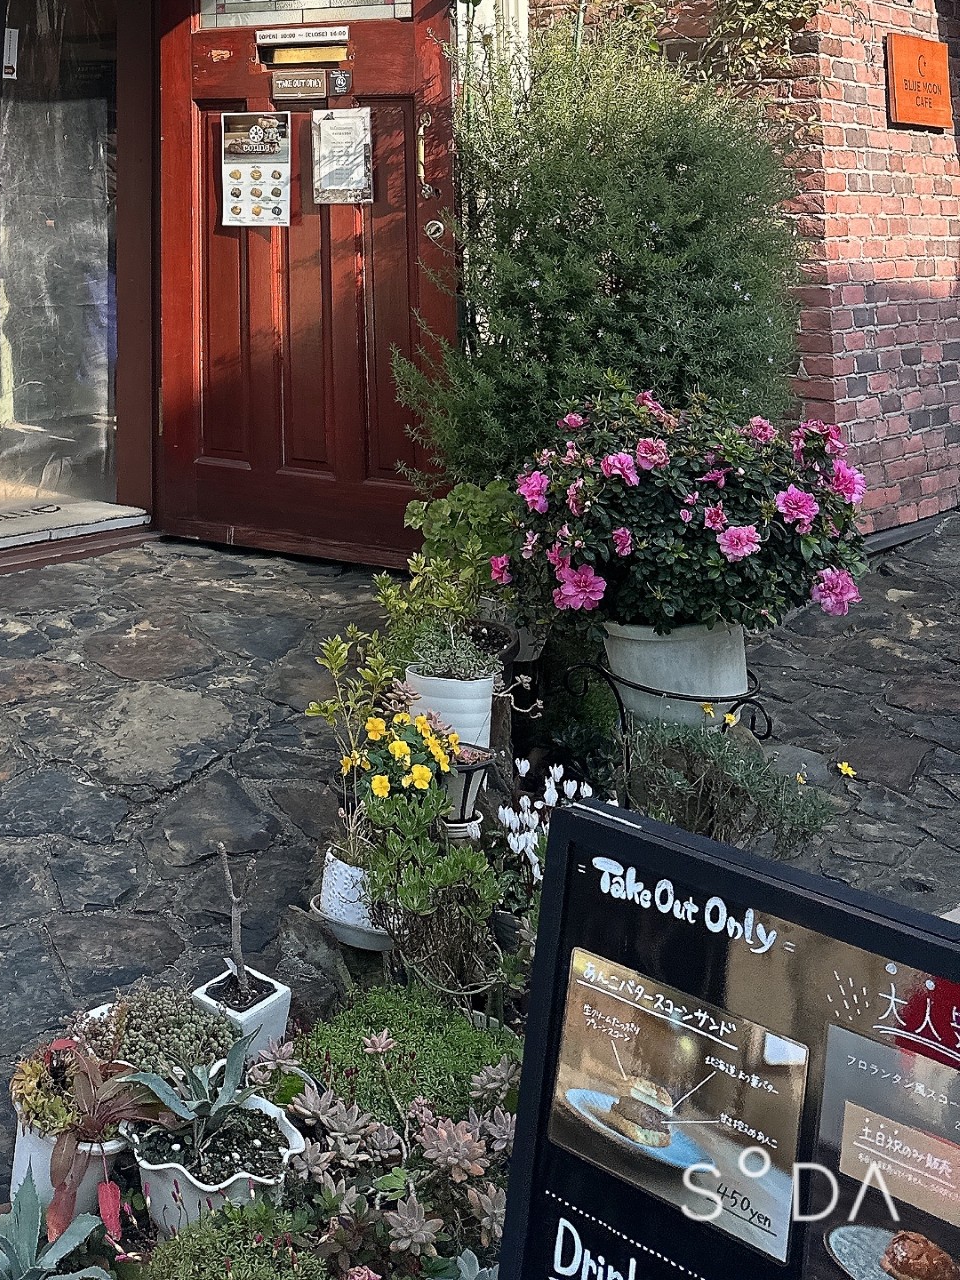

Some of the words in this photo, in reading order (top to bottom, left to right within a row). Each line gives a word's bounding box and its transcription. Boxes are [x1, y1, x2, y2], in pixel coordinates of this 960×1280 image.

[292, 80, 306, 88] OUT
[903, 78, 921, 92] BLUE
[922, 82, 942, 96] MOON
[915, 96, 933, 108] CAFE
[591, 856, 652, 909] Take
[654, 878, 700, 924] Out
[704, 896, 778, 955] Only
[583, 961, 738, 1037] あんこバタースコーンサンド
